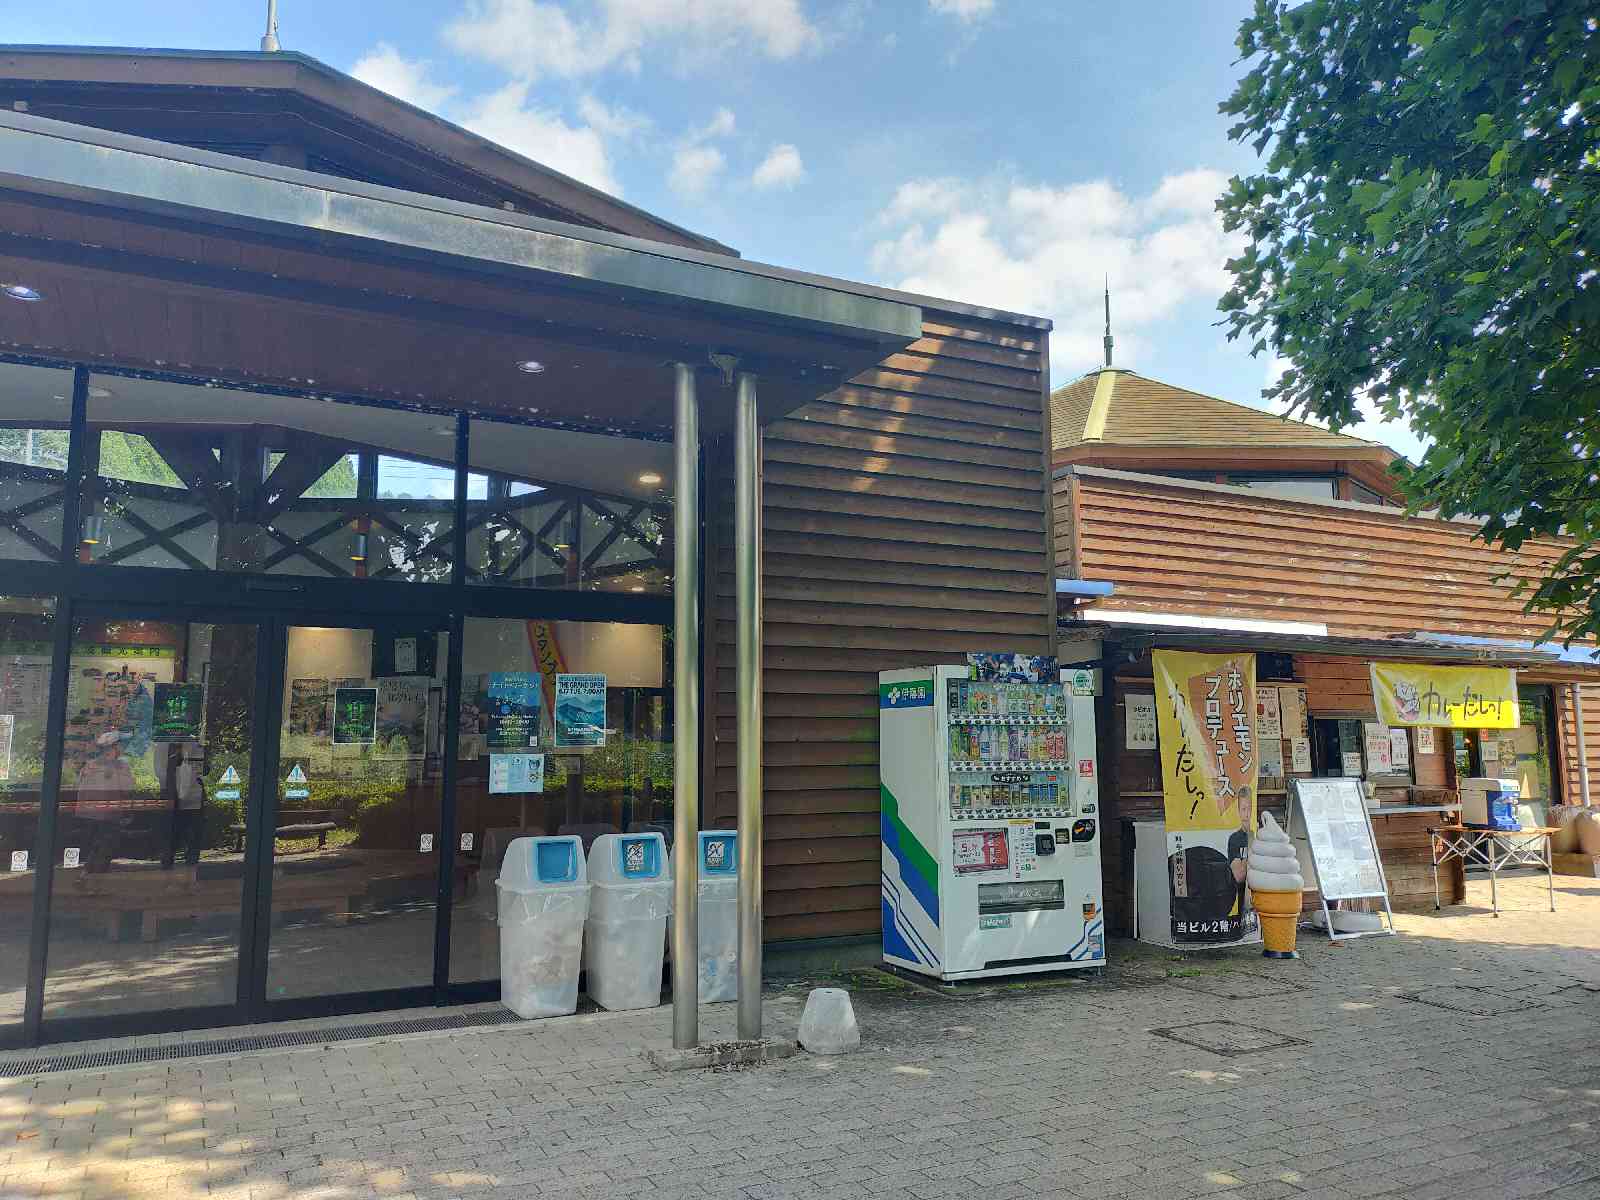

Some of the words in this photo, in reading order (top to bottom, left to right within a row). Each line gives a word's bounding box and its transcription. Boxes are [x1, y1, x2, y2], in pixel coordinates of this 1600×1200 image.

[1228, 668, 1253, 774] ホリエモン
